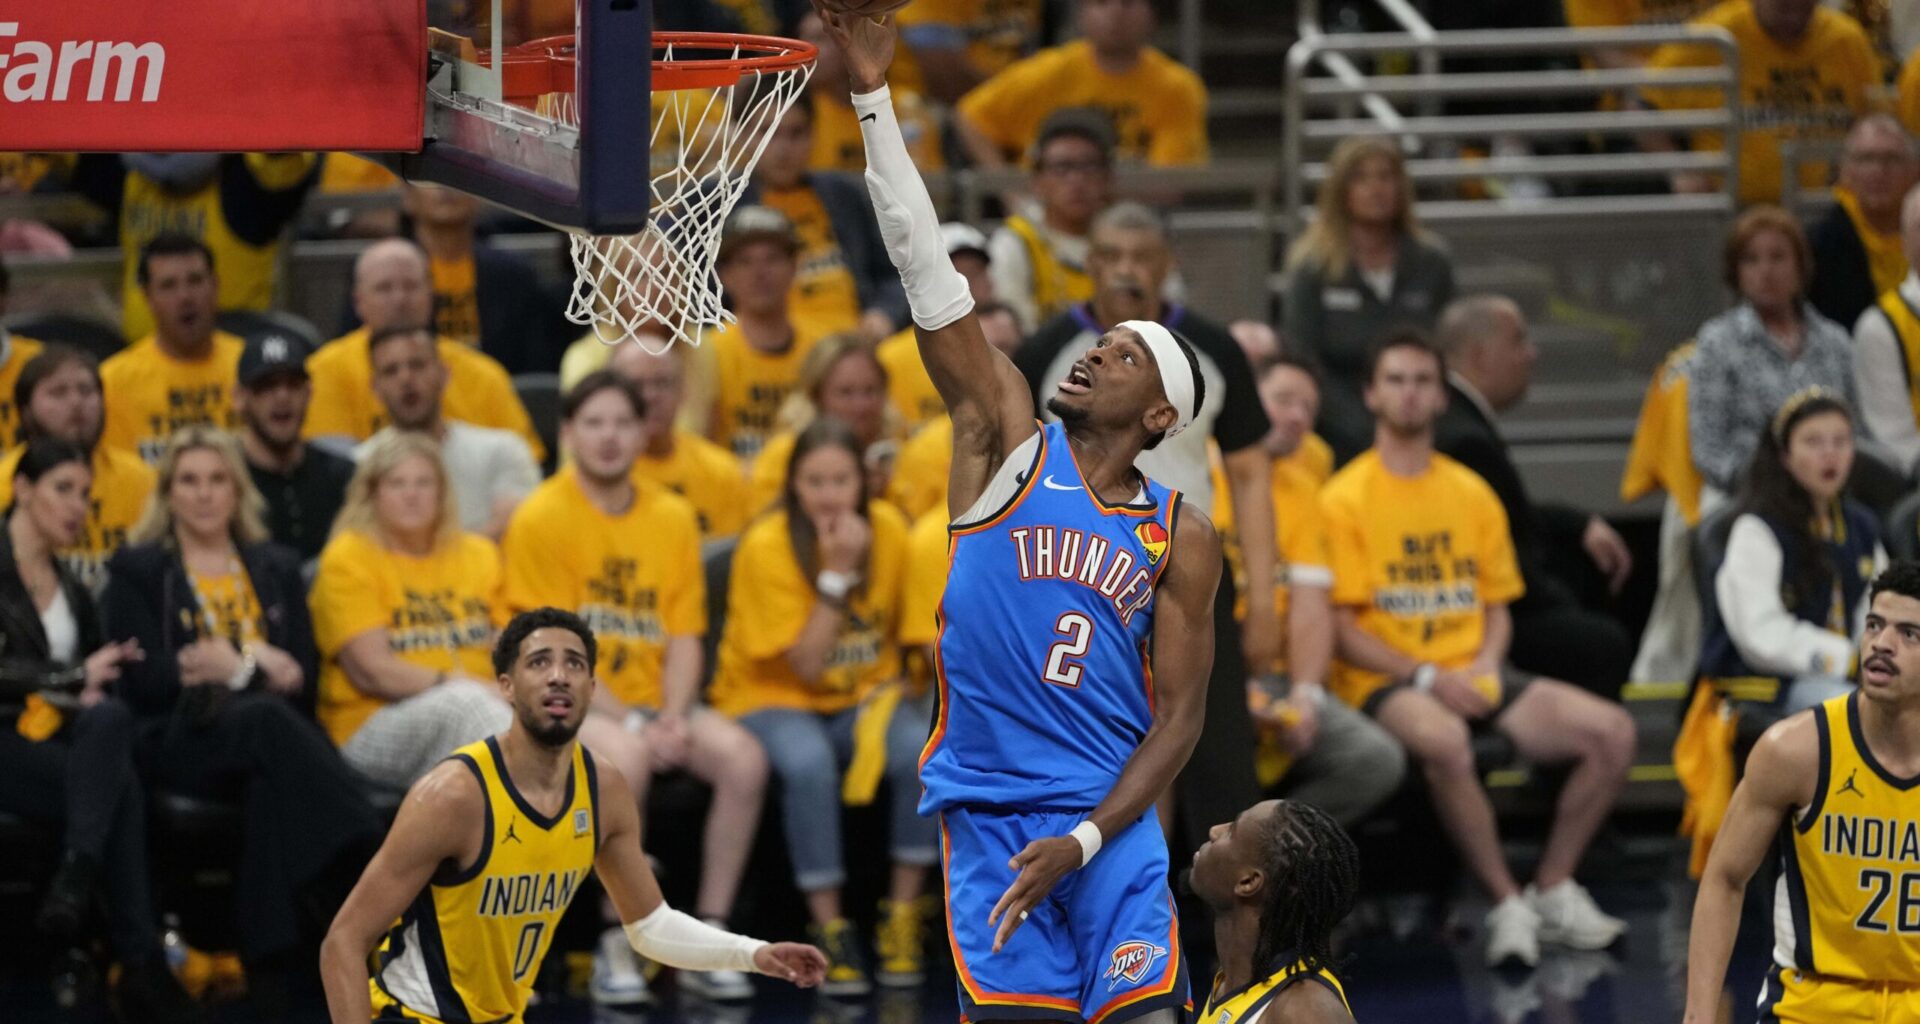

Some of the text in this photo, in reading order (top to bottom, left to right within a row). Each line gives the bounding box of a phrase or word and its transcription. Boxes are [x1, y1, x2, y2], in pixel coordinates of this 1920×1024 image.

[1010, 526, 1153, 628] THUNDER
[1043, 611, 1094, 688] 2
[477, 867, 586, 916] INDIAN
[1854, 868, 1920, 934] 26
[512, 920, 545, 983] 0
[1112, 947, 1145, 980] OKC
